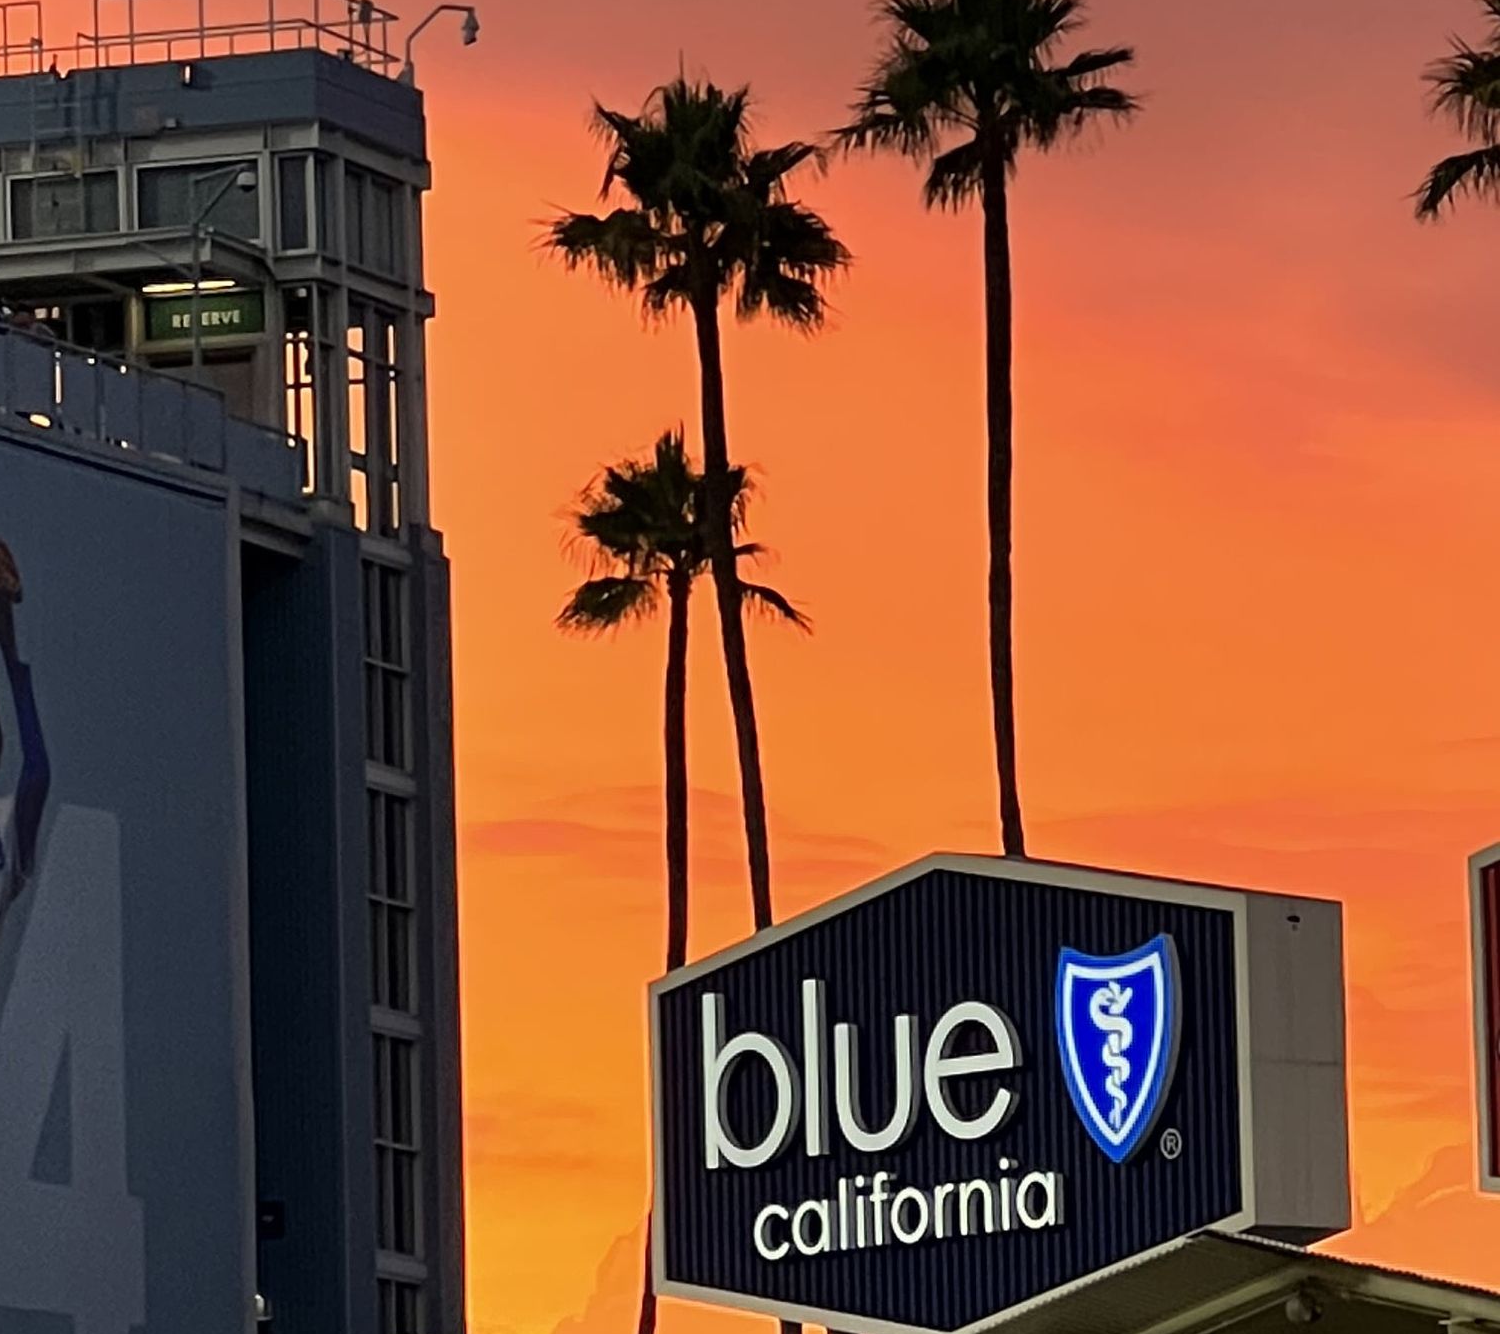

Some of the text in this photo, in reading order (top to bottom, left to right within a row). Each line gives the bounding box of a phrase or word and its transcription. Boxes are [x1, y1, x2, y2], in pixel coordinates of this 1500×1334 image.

[172, 309, 240, 328] REERVE
[702, 979, 1018, 1170] blue
[753, 1159, 1062, 1261] california
